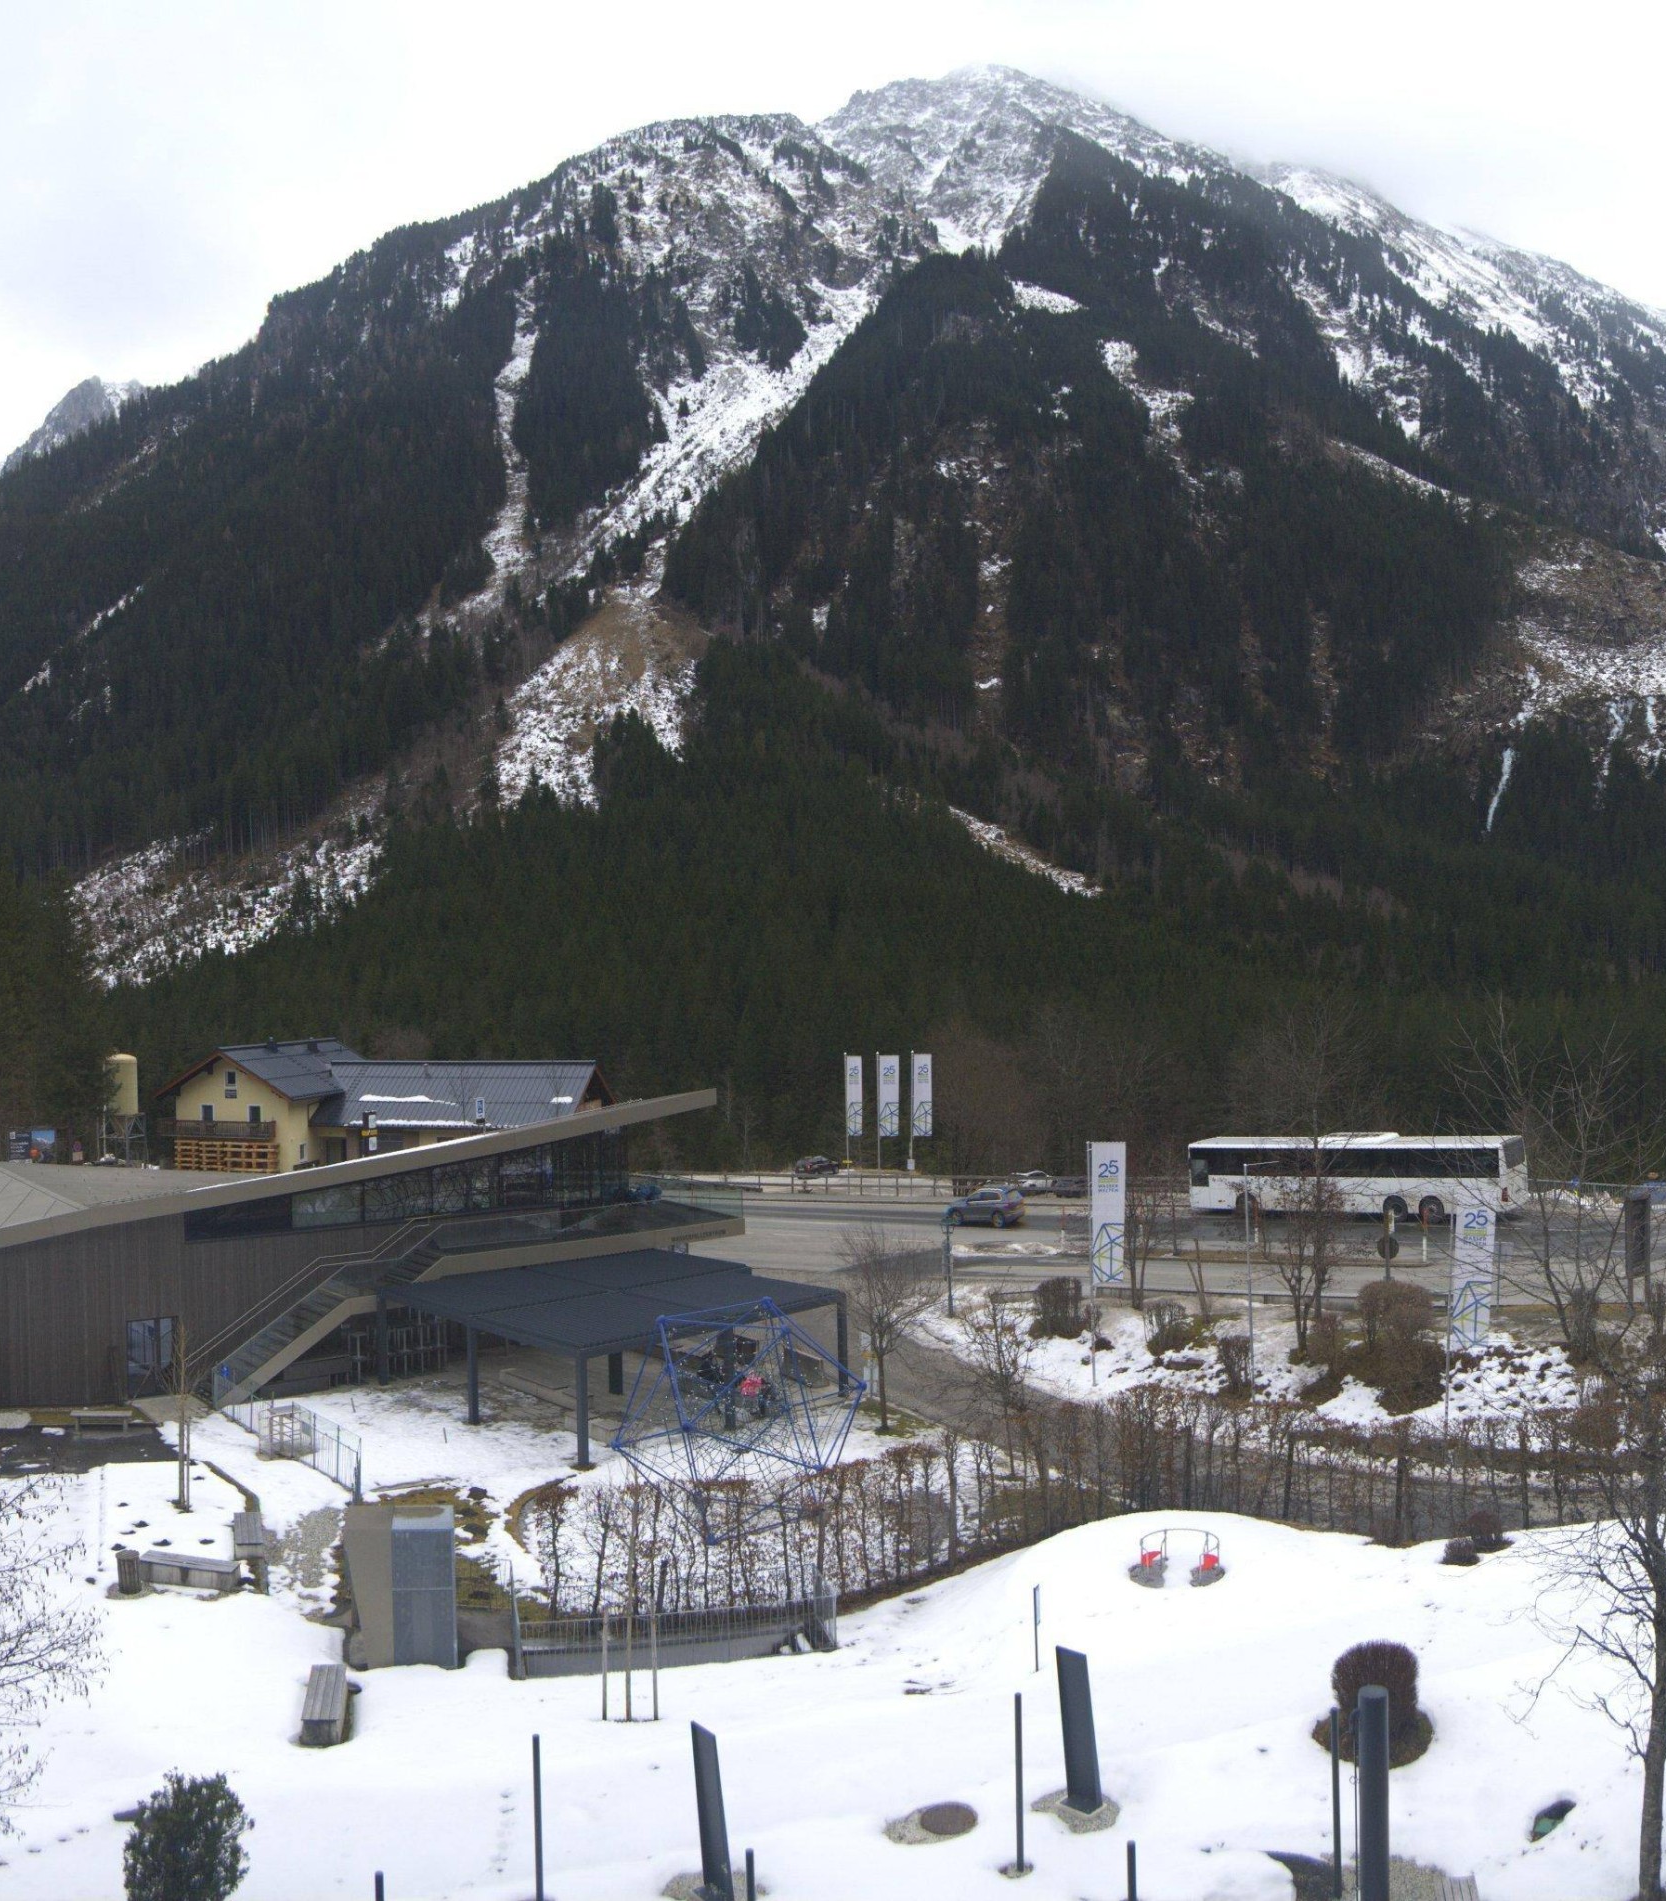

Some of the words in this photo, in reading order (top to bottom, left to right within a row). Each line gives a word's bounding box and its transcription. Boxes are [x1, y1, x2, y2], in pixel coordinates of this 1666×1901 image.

[849, 1065, 859, 1076] 25
[883, 1065, 895, 1076] 25
[918, 1064, 929, 1075] 25
[1098, 1160, 1119, 1178] 25
[1464, 1210, 1488, 1229] 25
